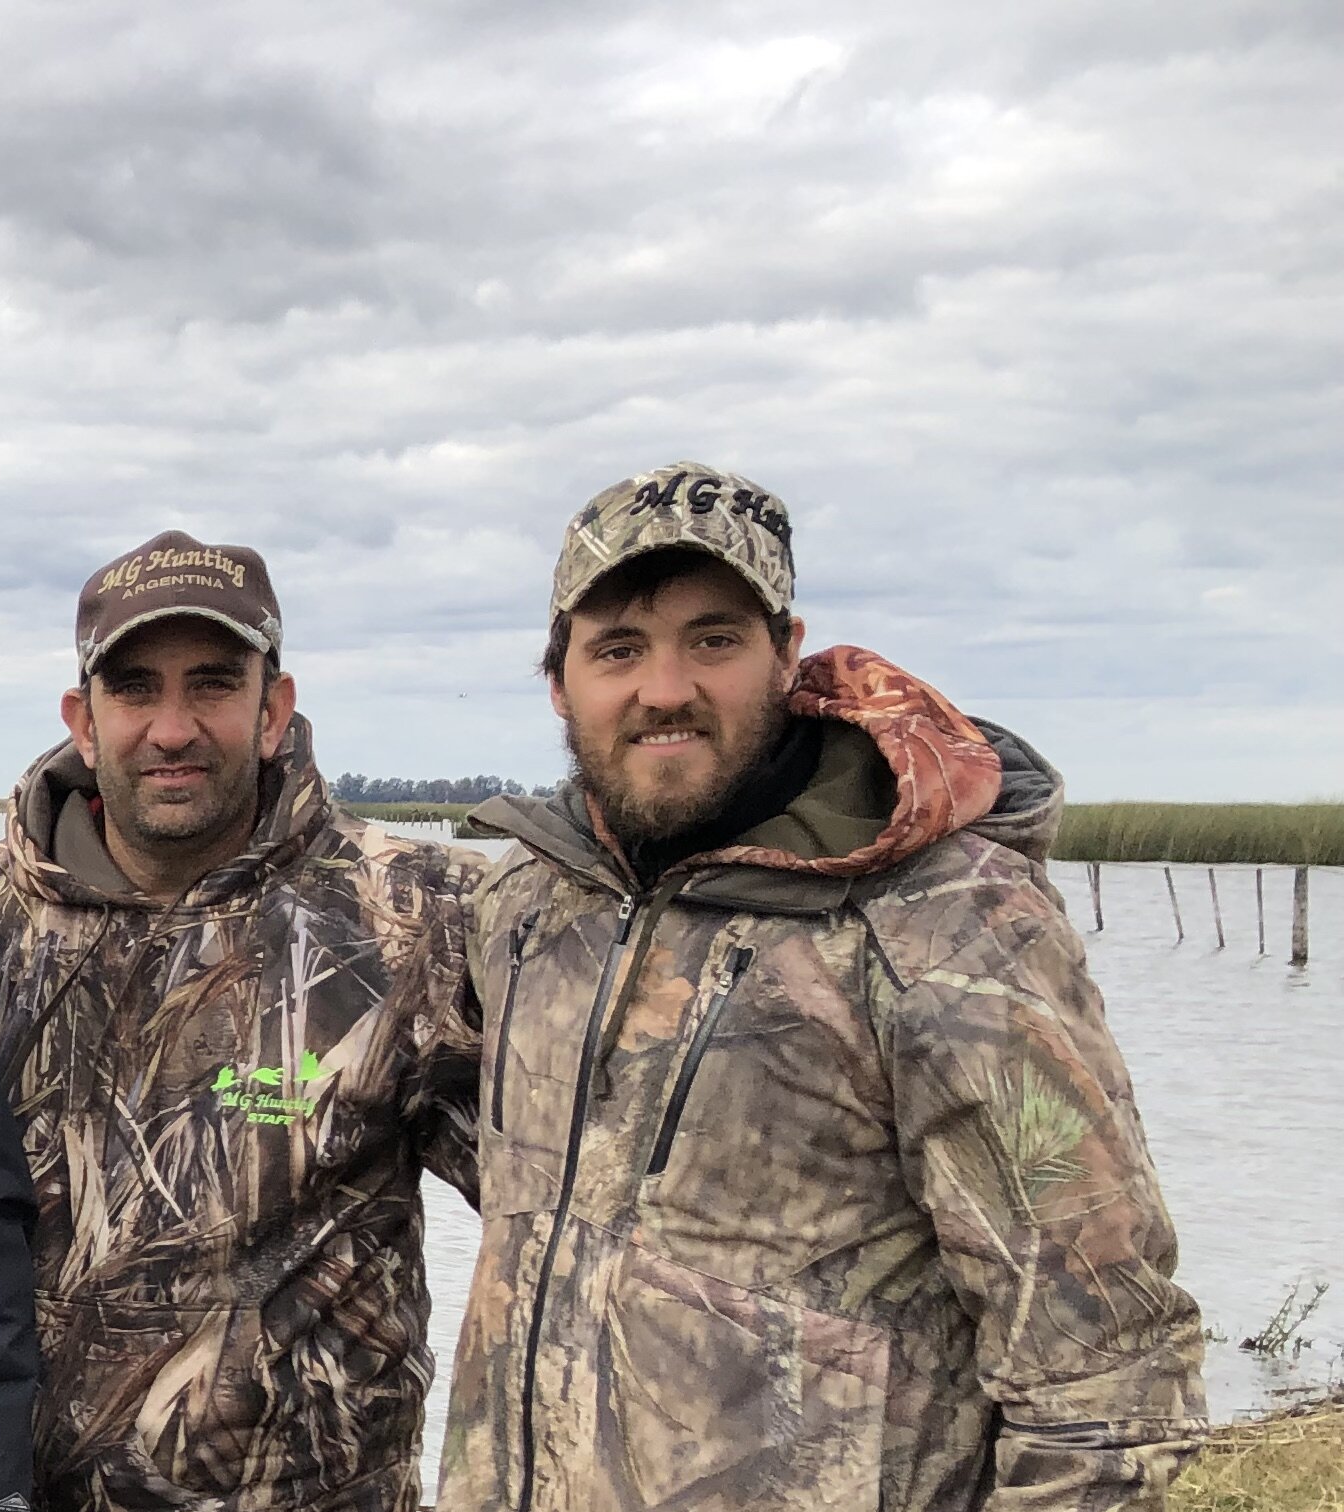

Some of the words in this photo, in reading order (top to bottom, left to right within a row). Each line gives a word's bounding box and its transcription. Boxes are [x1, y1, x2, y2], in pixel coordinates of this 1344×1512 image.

[630, 471, 721, 515] MG
[97, 555, 143, 595] MG
[146, 548, 246, 588] Hunting
[122, 574, 224, 600] ARGENTINA
[222, 1090, 252, 1110] MG
[247, 1112, 296, 1125] STAFF
